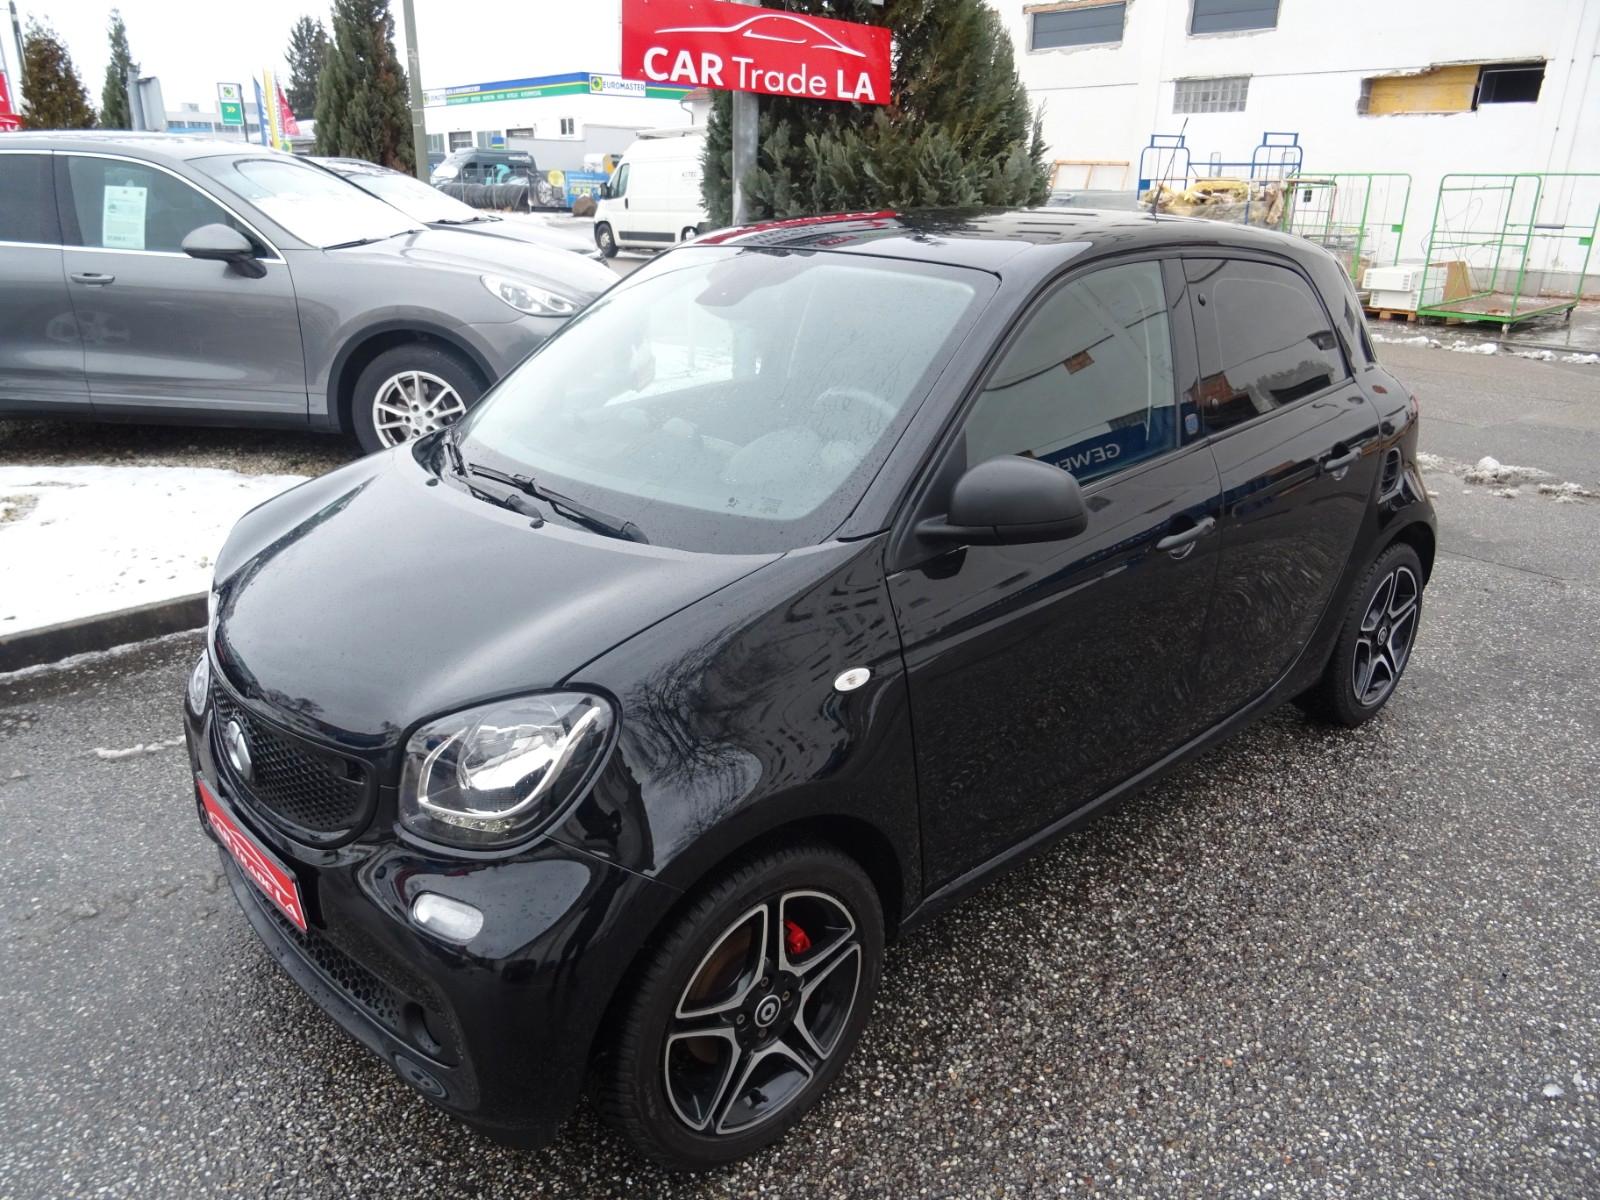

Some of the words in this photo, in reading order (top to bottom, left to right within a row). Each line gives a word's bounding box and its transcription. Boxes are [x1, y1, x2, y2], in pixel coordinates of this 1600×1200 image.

[602, 80, 645, 91] EUROMASTER
[643, 47, 724, 86] CAR
[732, 56, 827, 96] Trade
[836, 69, 876, 101] LA
